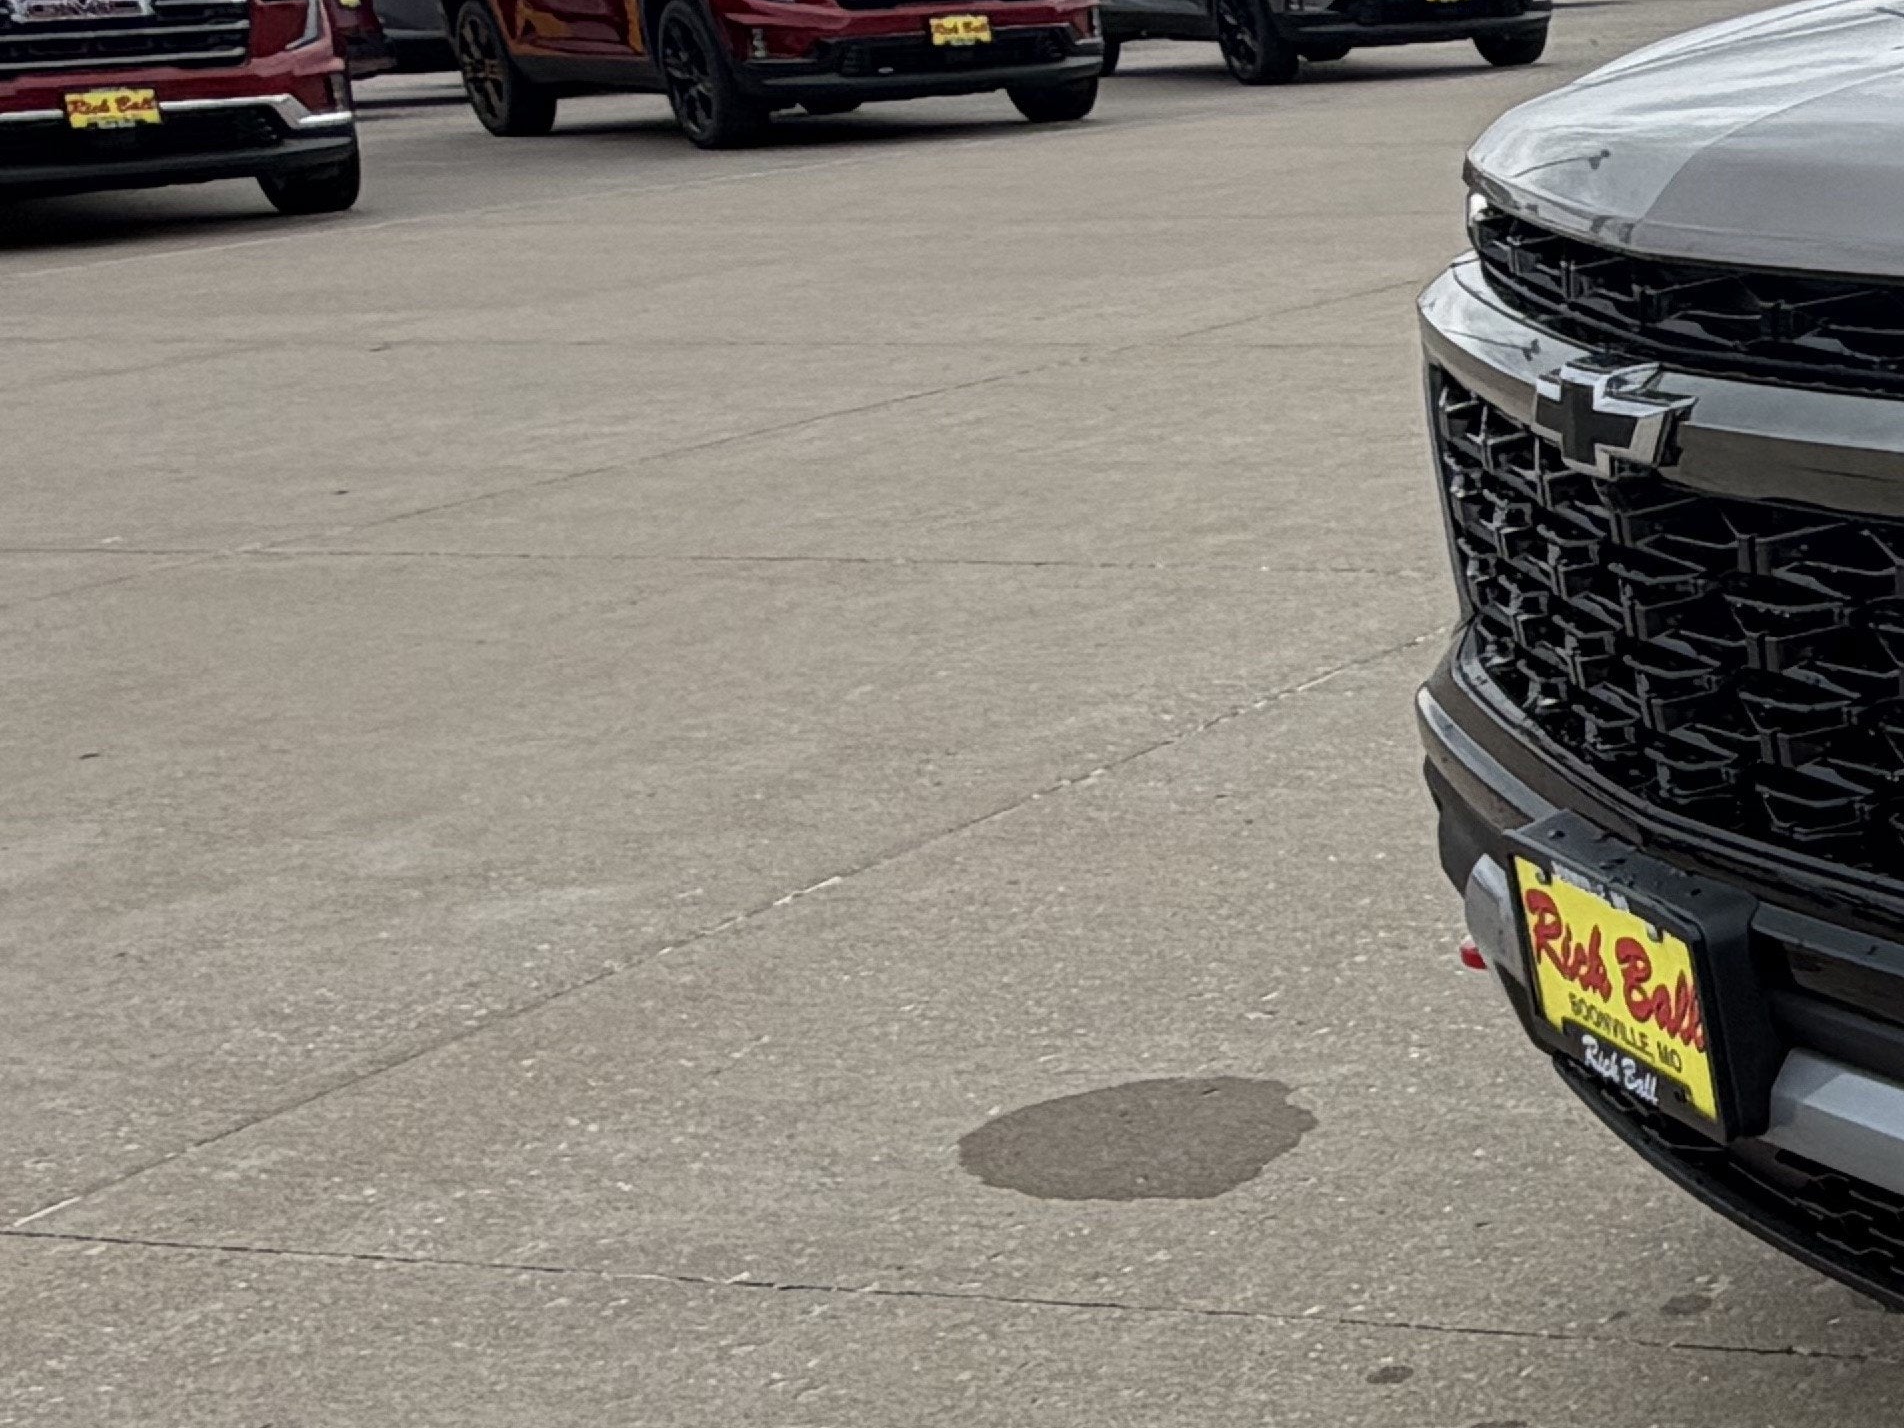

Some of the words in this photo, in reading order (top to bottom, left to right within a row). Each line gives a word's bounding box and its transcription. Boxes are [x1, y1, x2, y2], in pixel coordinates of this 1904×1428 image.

[1525, 888, 1613, 1003] Rick
[1615, 936, 1706, 1053] Ball
[1581, 1034, 1620, 1083] Rick
[1621, 1057, 1659, 1106] Ball
